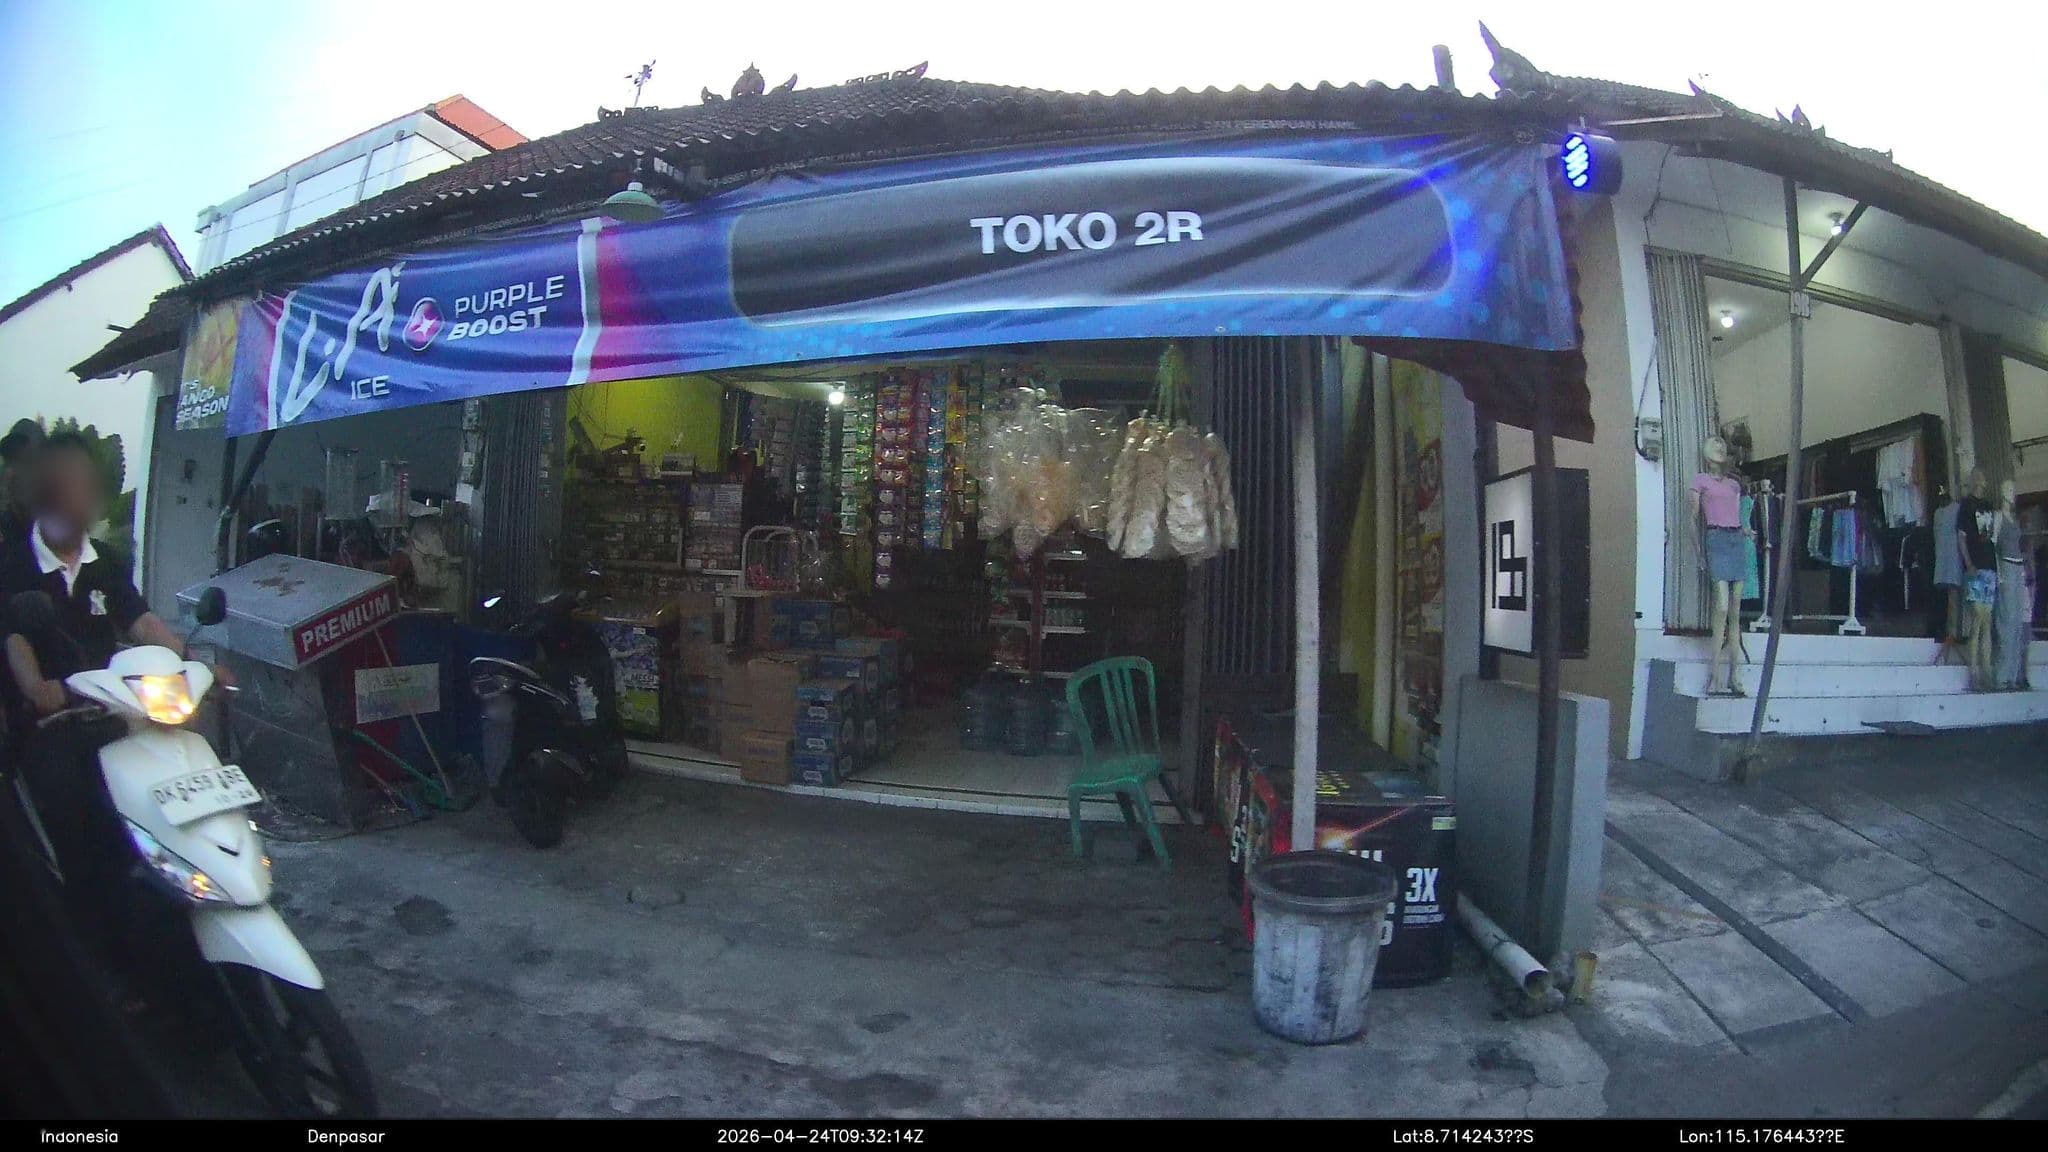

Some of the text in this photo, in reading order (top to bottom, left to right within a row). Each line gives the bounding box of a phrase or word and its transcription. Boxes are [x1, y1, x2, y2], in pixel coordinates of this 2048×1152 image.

[970, 211, 1204, 254] TOKO 2R
[454, 275, 565, 318] PURPLE
[446, 305, 548, 341] BOOST
[350, 375, 390, 400] ICE
[176, 395, 230, 424] SEASON
[301, 594, 391, 654] PREMIUM
[1405, 867, 1439, 903] 3X
